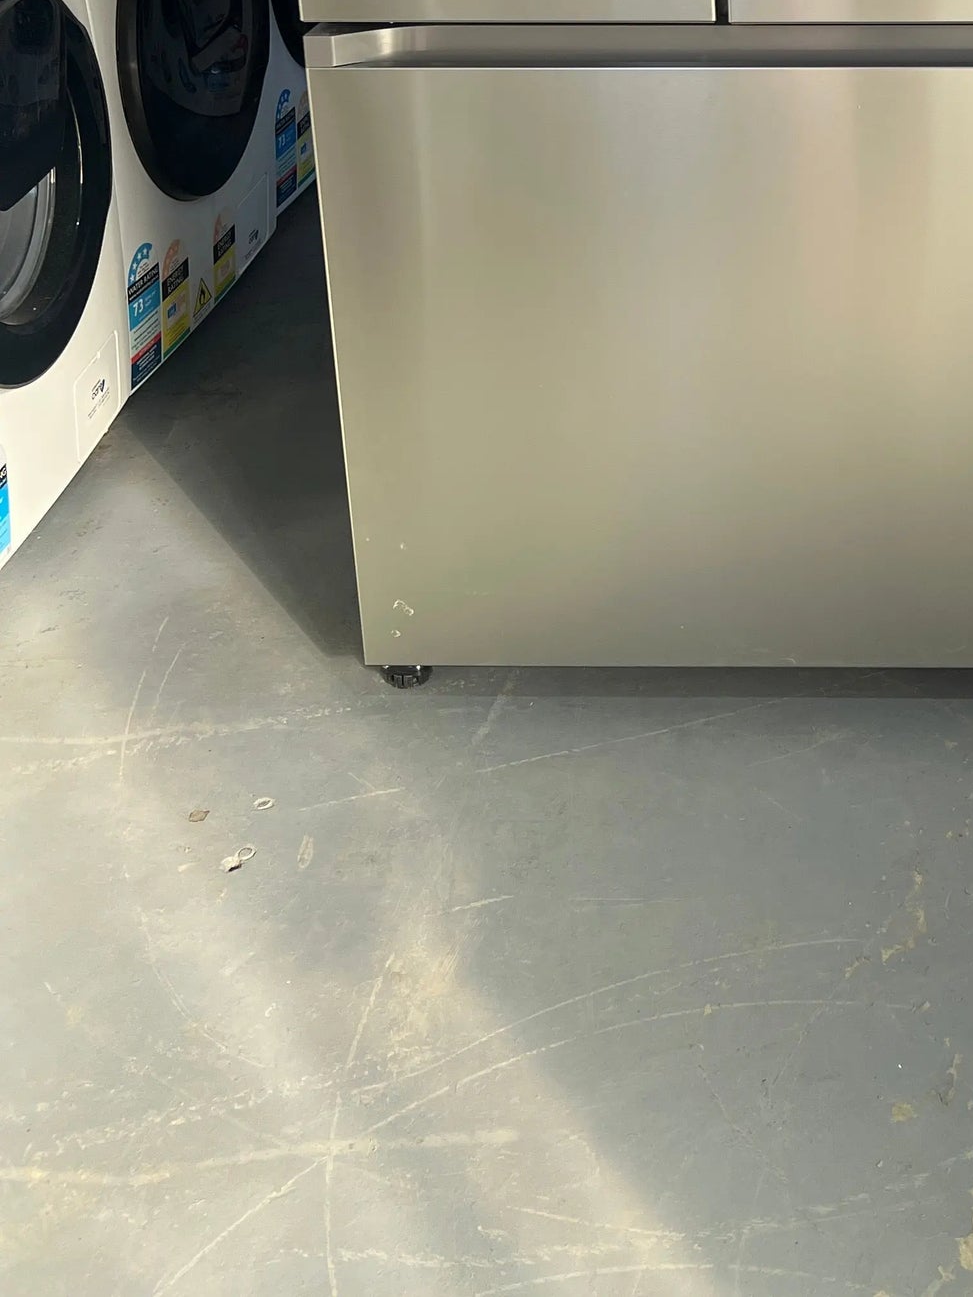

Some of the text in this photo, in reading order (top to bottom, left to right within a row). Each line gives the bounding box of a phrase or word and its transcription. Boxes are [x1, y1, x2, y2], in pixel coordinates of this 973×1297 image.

[128, 279, 144, 295] WATER
[143, 265, 159, 283] RATING
[132, 298, 144, 317] 73
